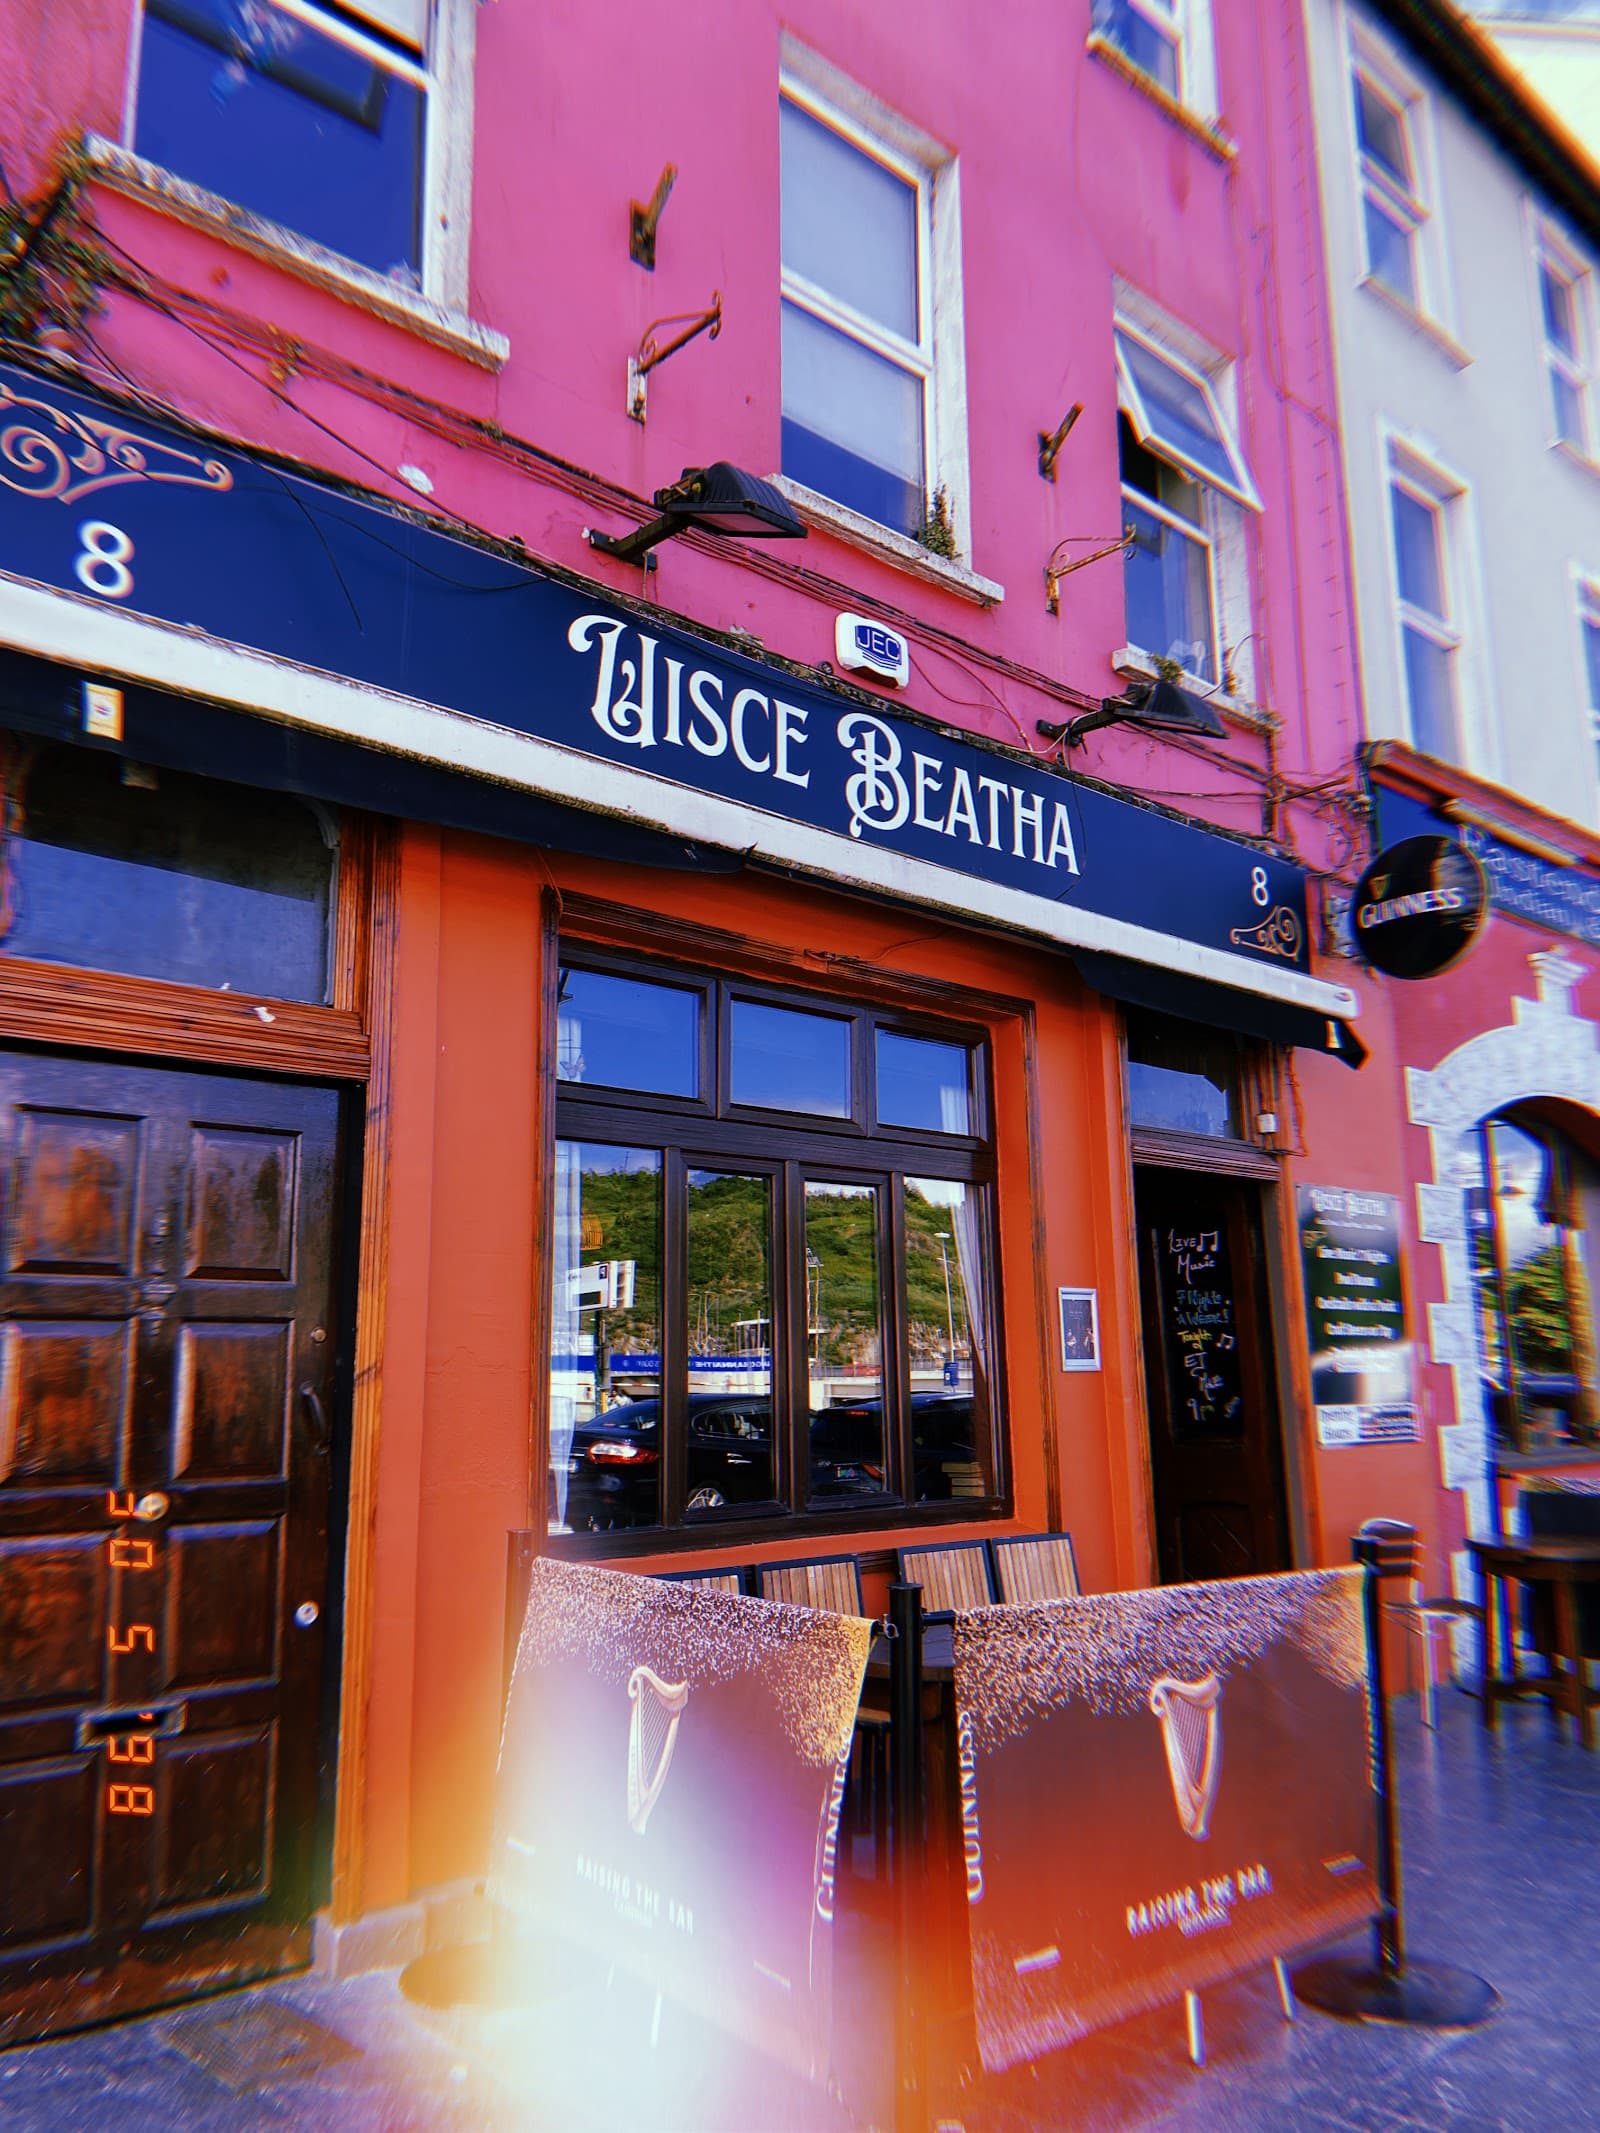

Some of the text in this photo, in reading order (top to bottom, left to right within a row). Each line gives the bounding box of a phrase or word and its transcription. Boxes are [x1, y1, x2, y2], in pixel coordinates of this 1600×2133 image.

[74, 519, 135, 599] 8
[856, 628, 901, 661] JEC
[568, 615, 1081, 876] UISCE BEATHA
[1251, 866, 1269, 906] 8
[1357, 887, 1465, 929] GUINNESS
[1177, 1253, 1216, 1285] Music
[1126, 1885, 1199, 1938] RAISING
[1201, 1874, 1237, 1906] THE
[1237, 1863, 1273, 1900] BAR
